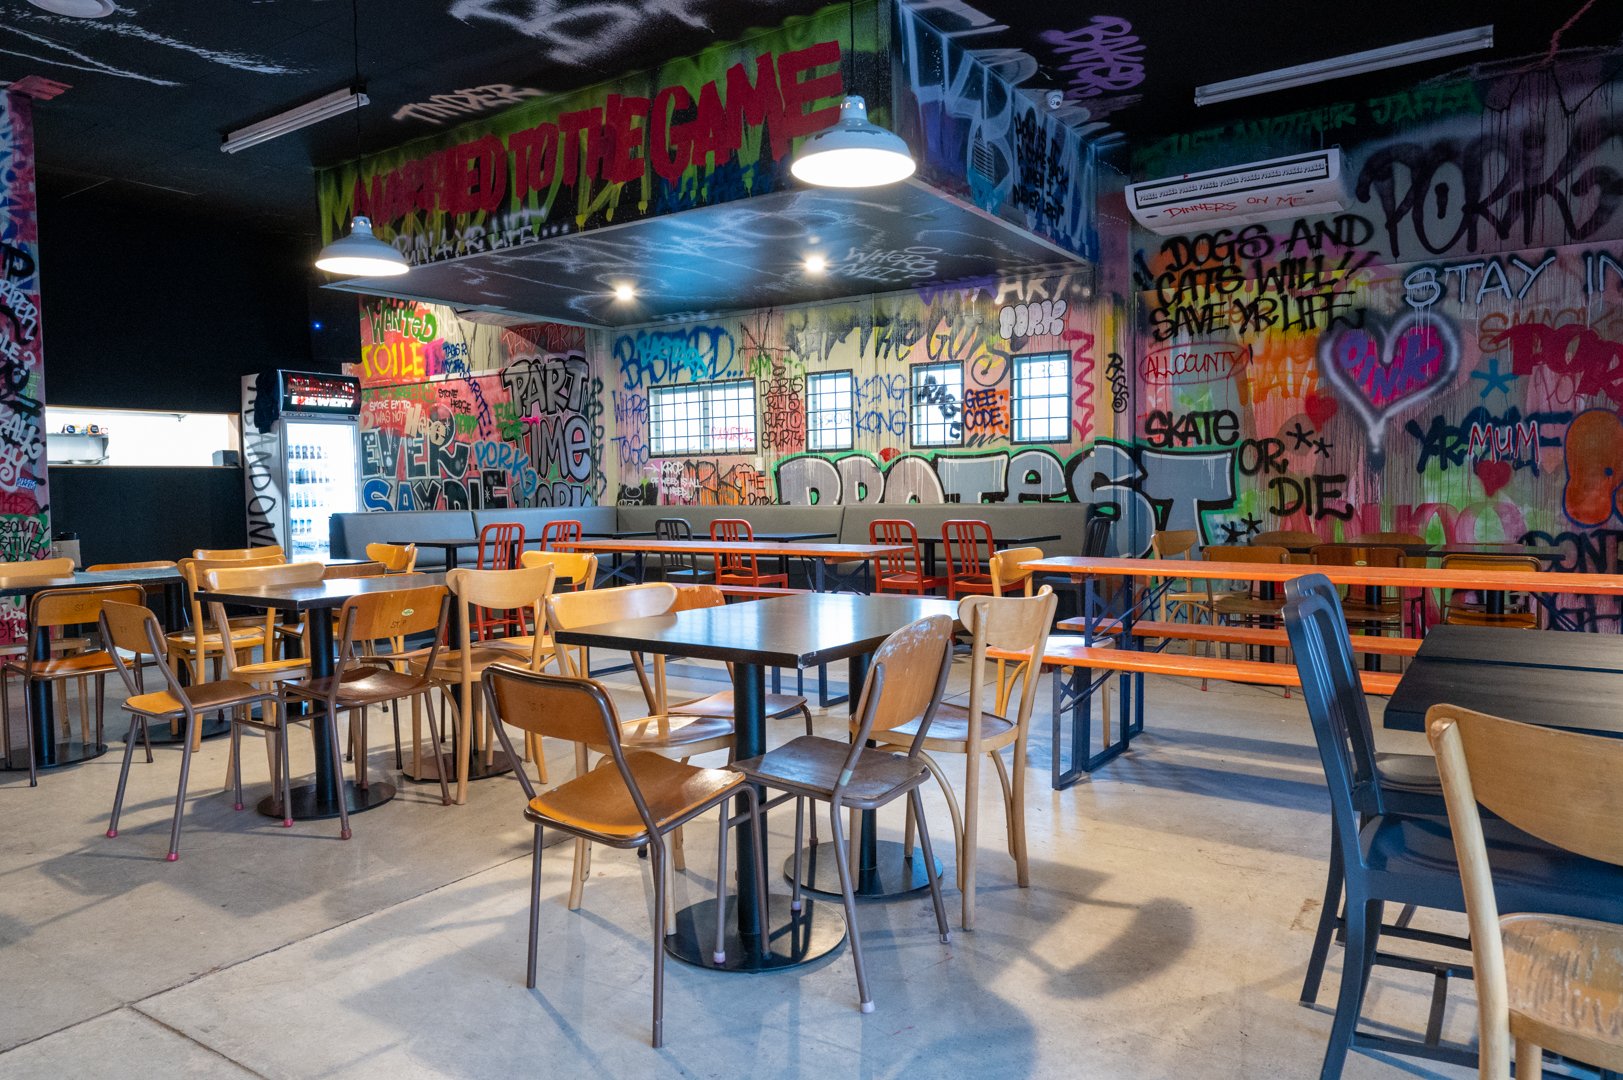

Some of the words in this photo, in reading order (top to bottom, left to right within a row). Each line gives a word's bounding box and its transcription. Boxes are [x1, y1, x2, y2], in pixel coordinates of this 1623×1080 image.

[508, 122, 560, 202] TO
[558, 93, 651, 190] THE
[650, 40, 843, 188] GAME
[1163, 202, 1237, 219] DINNERS
[1246, 195, 1269, 205] ON
[1276, 196, 1305, 209] ME
[1160, 224, 1275, 272] DOGS
[1281, 213, 1374, 254] AND
[1156, 265, 1247, 310] CATS
[1405, 255, 1556, 307] STAY
[1000, 299, 1067, 340] PORK
[1149, 301, 1230, 342] SAVE
[1282, 291, 1366, 333] LIFE
[361, 337, 445, 379] TOILET
[502, 354, 590, 416] PART
[854, 374, 908, 408] KING
[375, 411, 390, 425] WAS
[854, 411, 908, 438] KONG
[1238, 438, 1289, 477] OR
[363, 478, 444, 512] SAY
[443, 470, 508, 510] DIE
[1268, 473, 1354, 521] DIE
